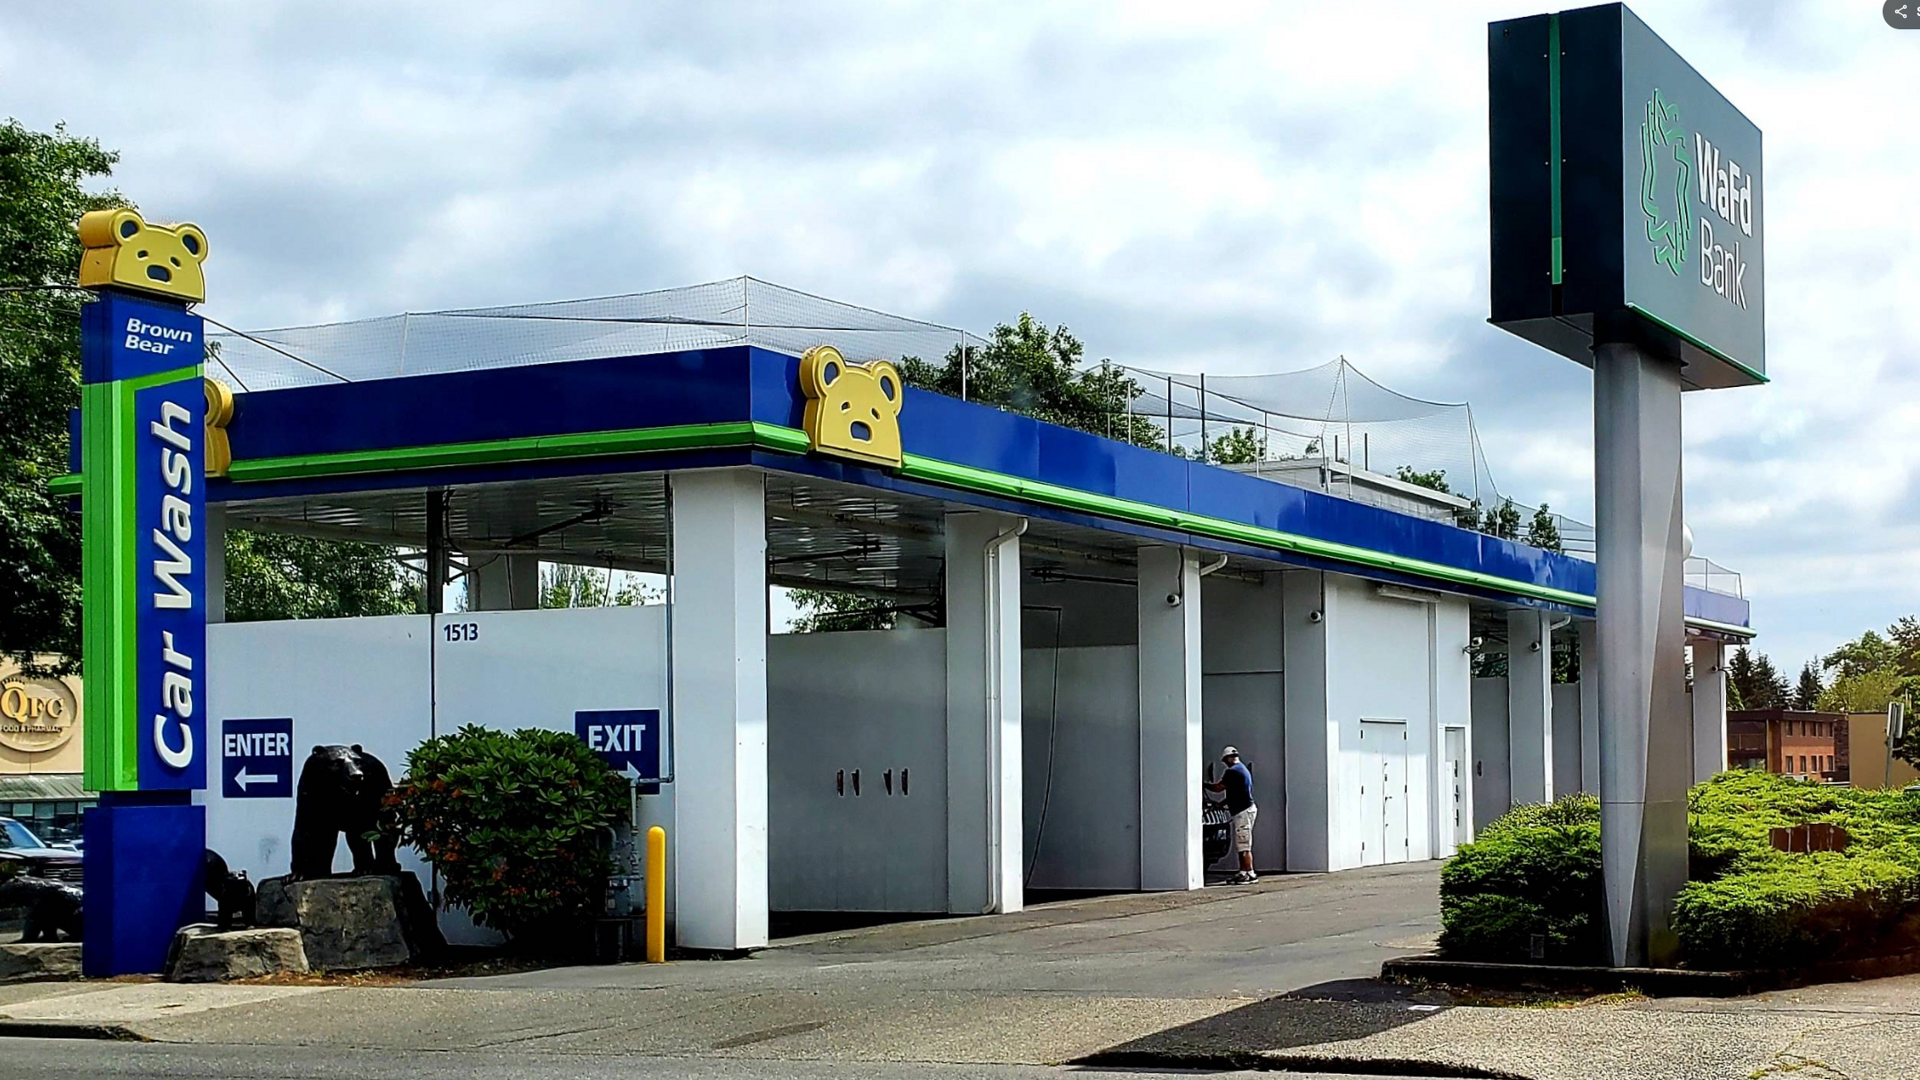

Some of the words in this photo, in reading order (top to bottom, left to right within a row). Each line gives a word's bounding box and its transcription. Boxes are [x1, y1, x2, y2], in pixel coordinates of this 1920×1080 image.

[1694, 132, 1752, 237] WaFd
[1700, 216, 1747, 310] Bank
[124, 334, 175, 355] Bear
[126, 317, 193, 343] Brown
[151, 400, 193, 609] Wash
[443, 623, 479, 642] 1513
[0, 688, 65, 724] QFC
[154, 630, 194, 768] Car
[224, 732, 290, 757] ENTER
[588, 724, 646, 752] EXIT
